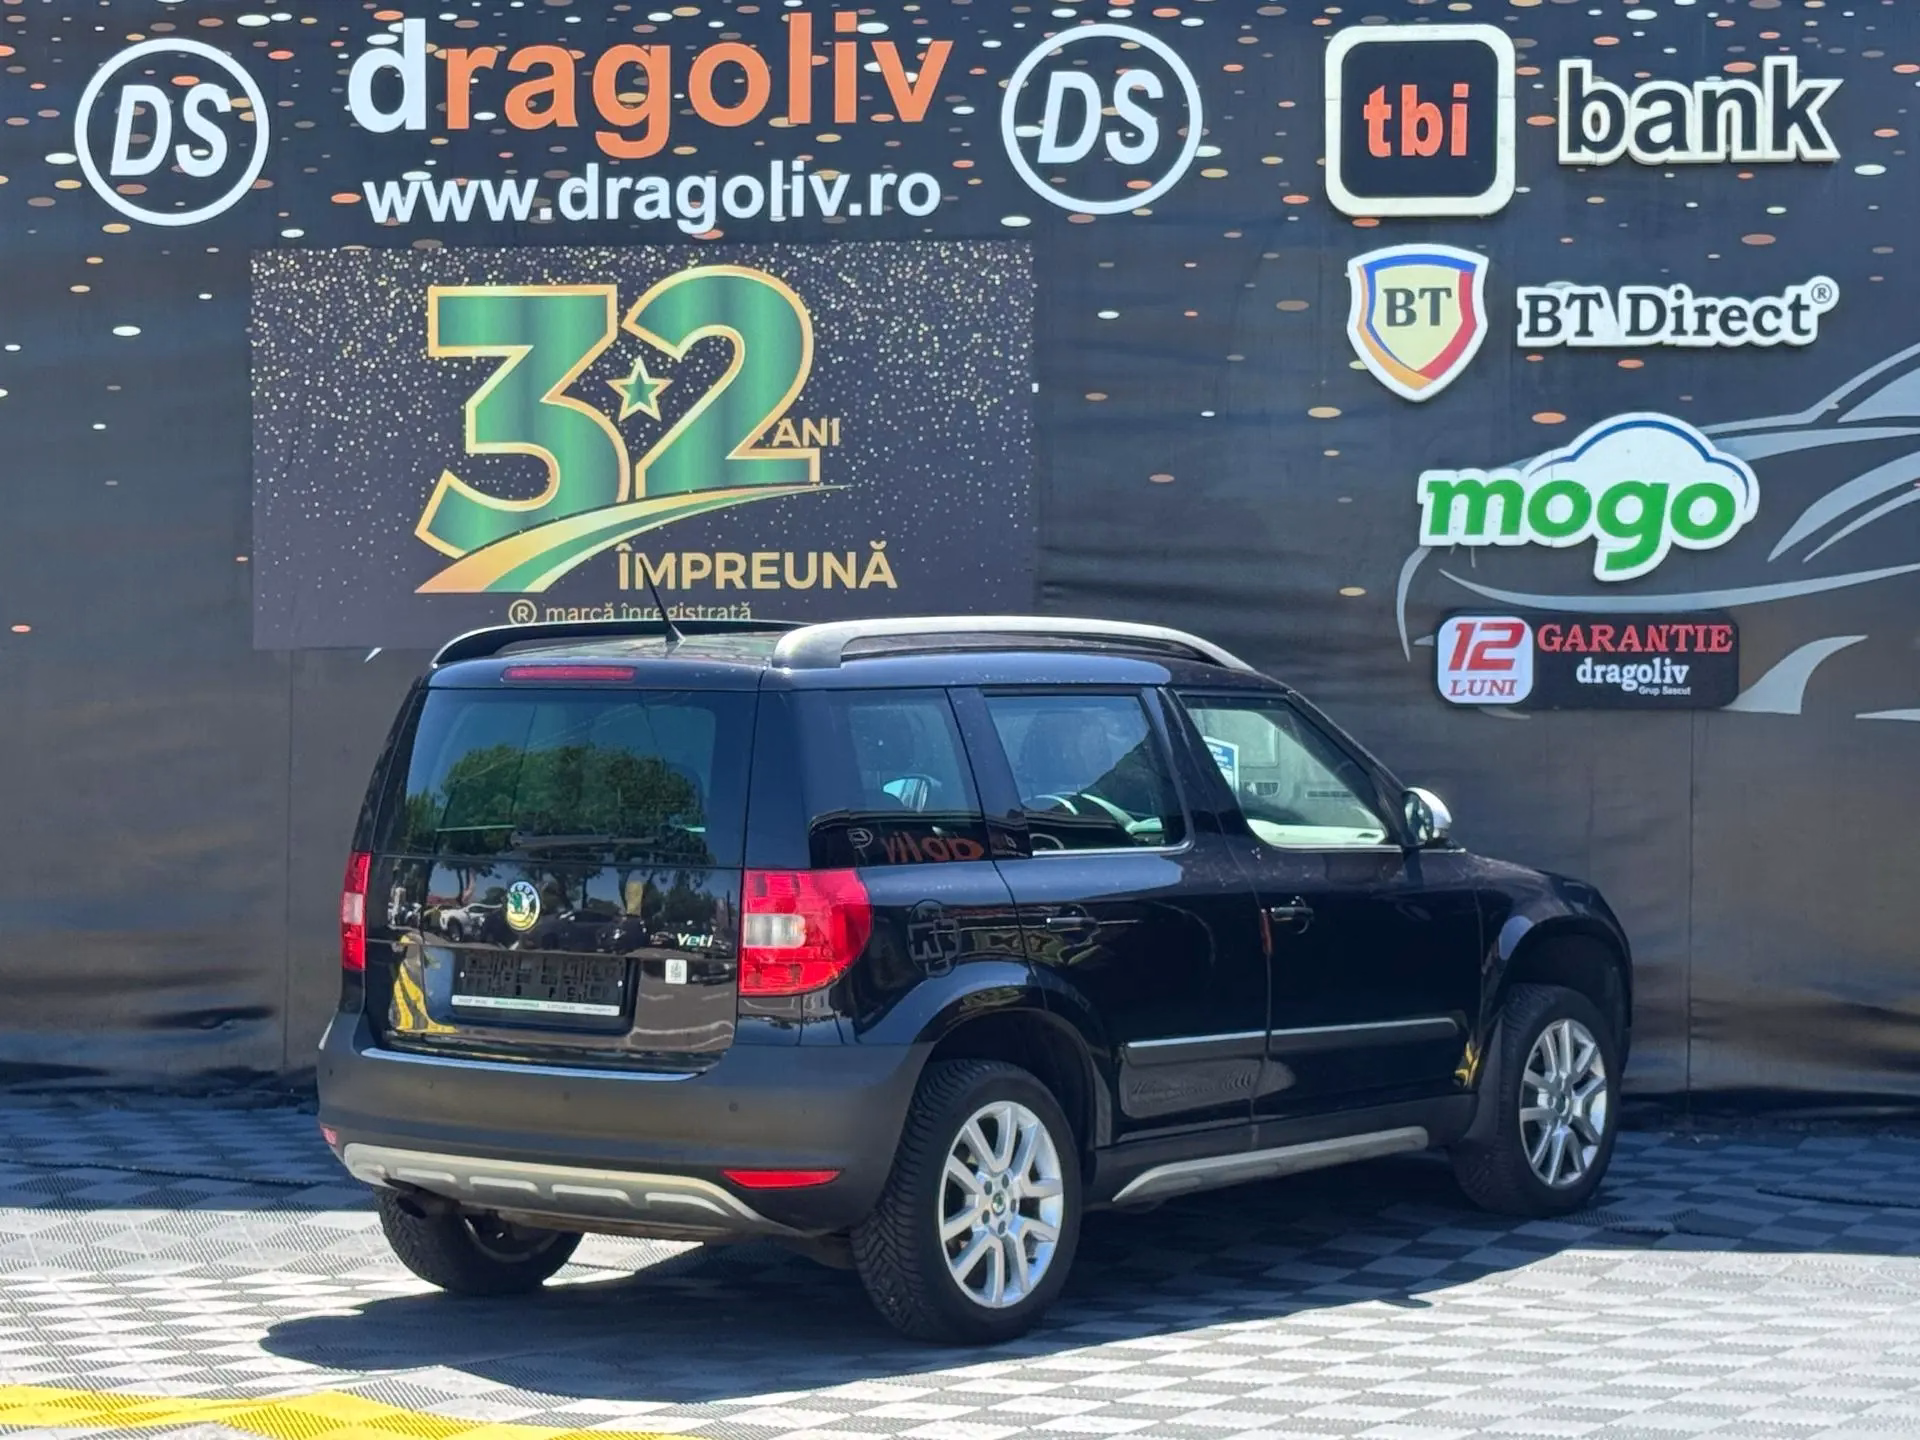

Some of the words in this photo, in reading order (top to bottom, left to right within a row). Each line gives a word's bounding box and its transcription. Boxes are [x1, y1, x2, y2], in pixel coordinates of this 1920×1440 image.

[348, 12, 954, 158] dragoliv
[1363, 83, 1470, 158] tbi
[1562, 58, 1841, 161] bank
[110, 84, 232, 177] DS
[1037, 69, 1164, 165] DS
[363, 158, 941, 234] www.dragoliv.ro
[1383, 287, 1452, 327] BT
[1524, 293, 1602, 338] BT
[414, 264, 820, 560] 32
[772, 417, 841, 447] ANI
[1427, 478, 1736, 571] mogo
[616, 540, 898, 590] ÎMPREUNĂ
[1448, 622, 1525, 671] 12
[1537, 624, 1733, 653] GARANTIE
[1449, 679, 1518, 697] LUNI
[1576, 657, 1690, 691] dragoliv
